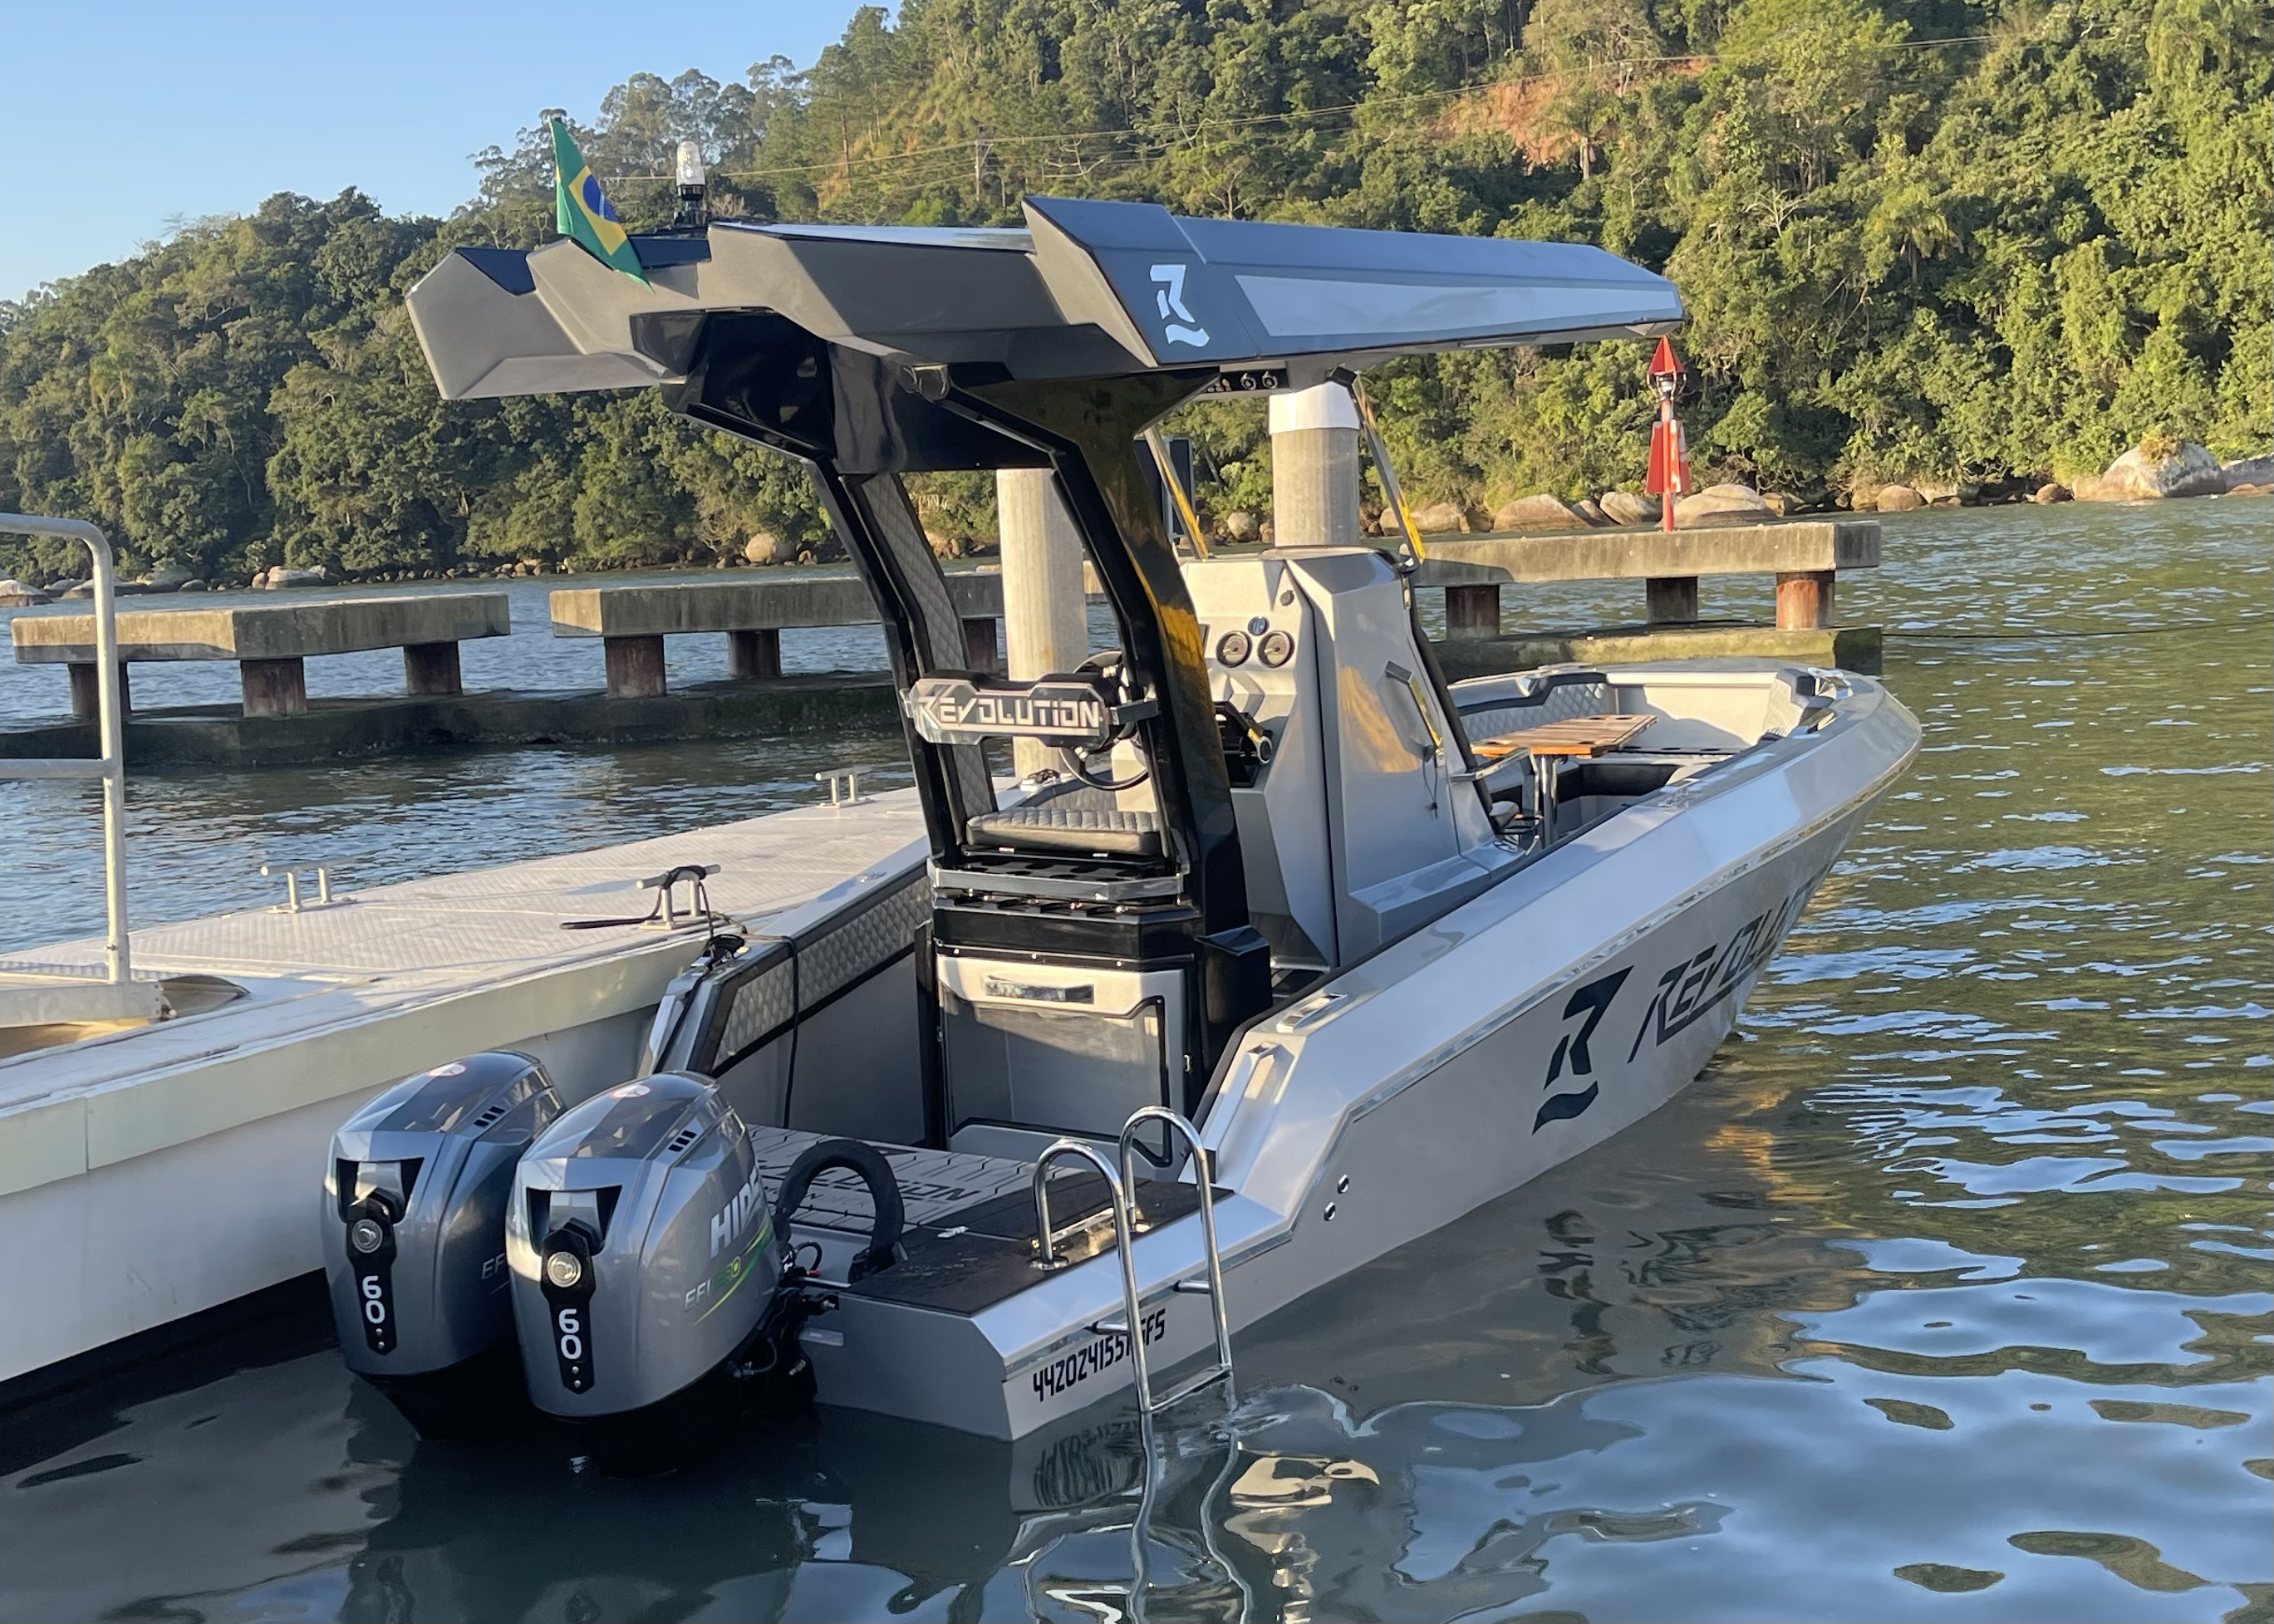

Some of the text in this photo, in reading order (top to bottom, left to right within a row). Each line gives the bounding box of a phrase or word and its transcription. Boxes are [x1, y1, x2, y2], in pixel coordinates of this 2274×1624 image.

[917, 696, 1099, 729] REVOLUTION
[482, 1252, 505, 1279] EF
[362, 1275, 386, 1324] 60
[685, 1278, 711, 1310] EFI
[559, 1308, 582, 1359] 60
